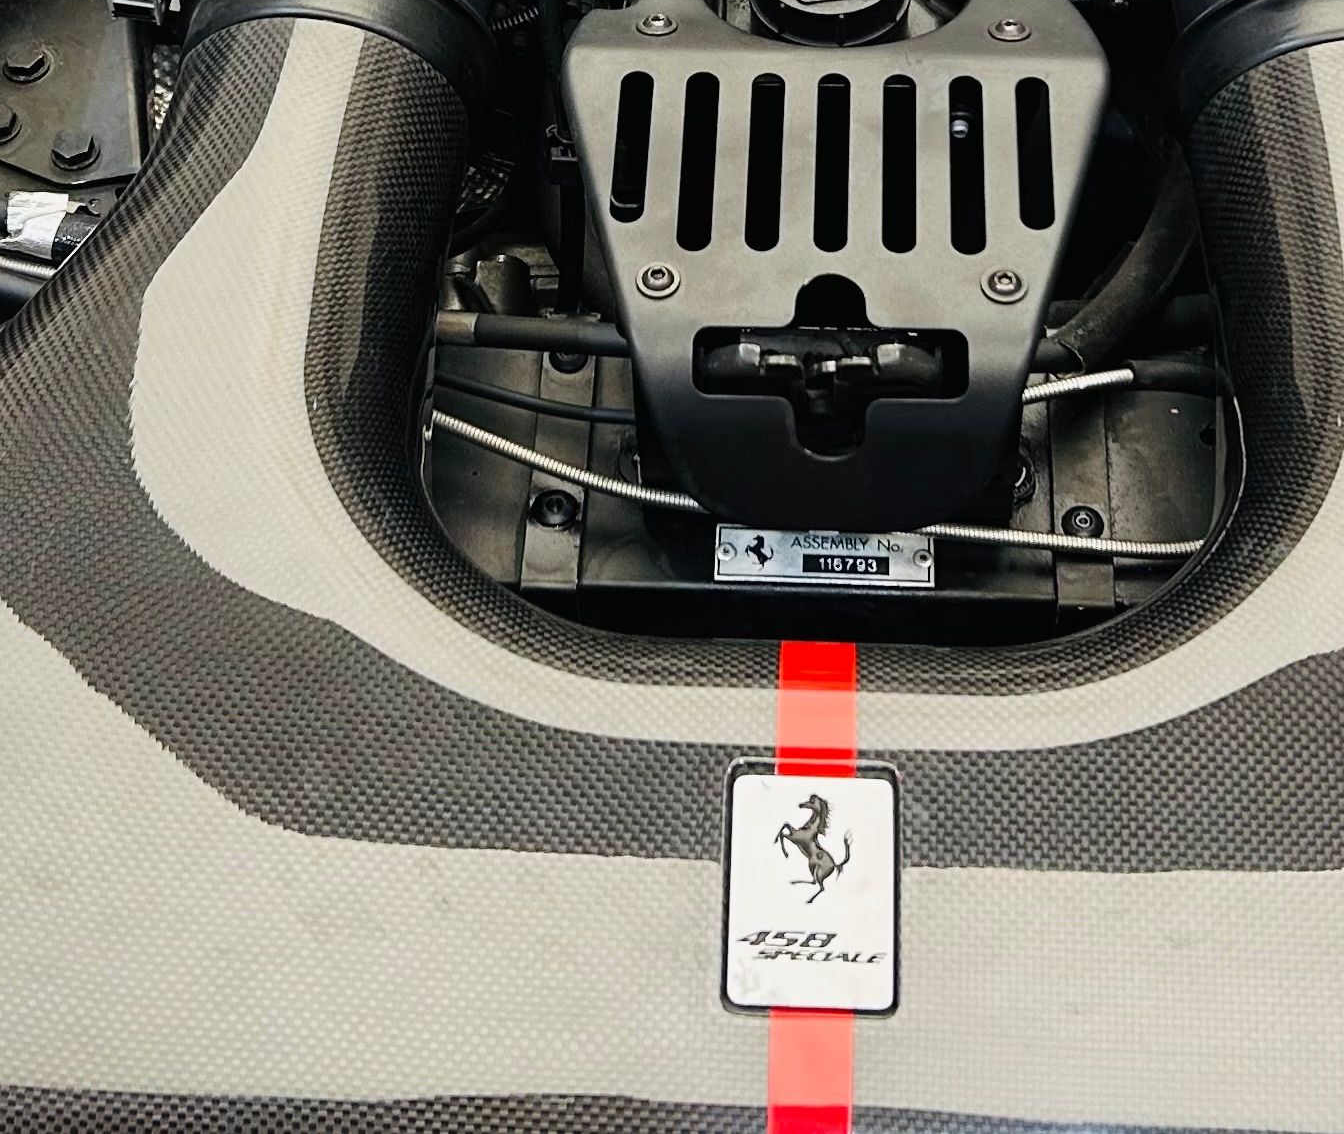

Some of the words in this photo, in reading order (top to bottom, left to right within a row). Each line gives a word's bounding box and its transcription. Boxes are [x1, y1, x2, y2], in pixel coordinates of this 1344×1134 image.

[791, 535, 869, 552] ASSEMBLY
[737, 929, 837, 949] 458
[752, 948, 887, 965] SPECIALE
